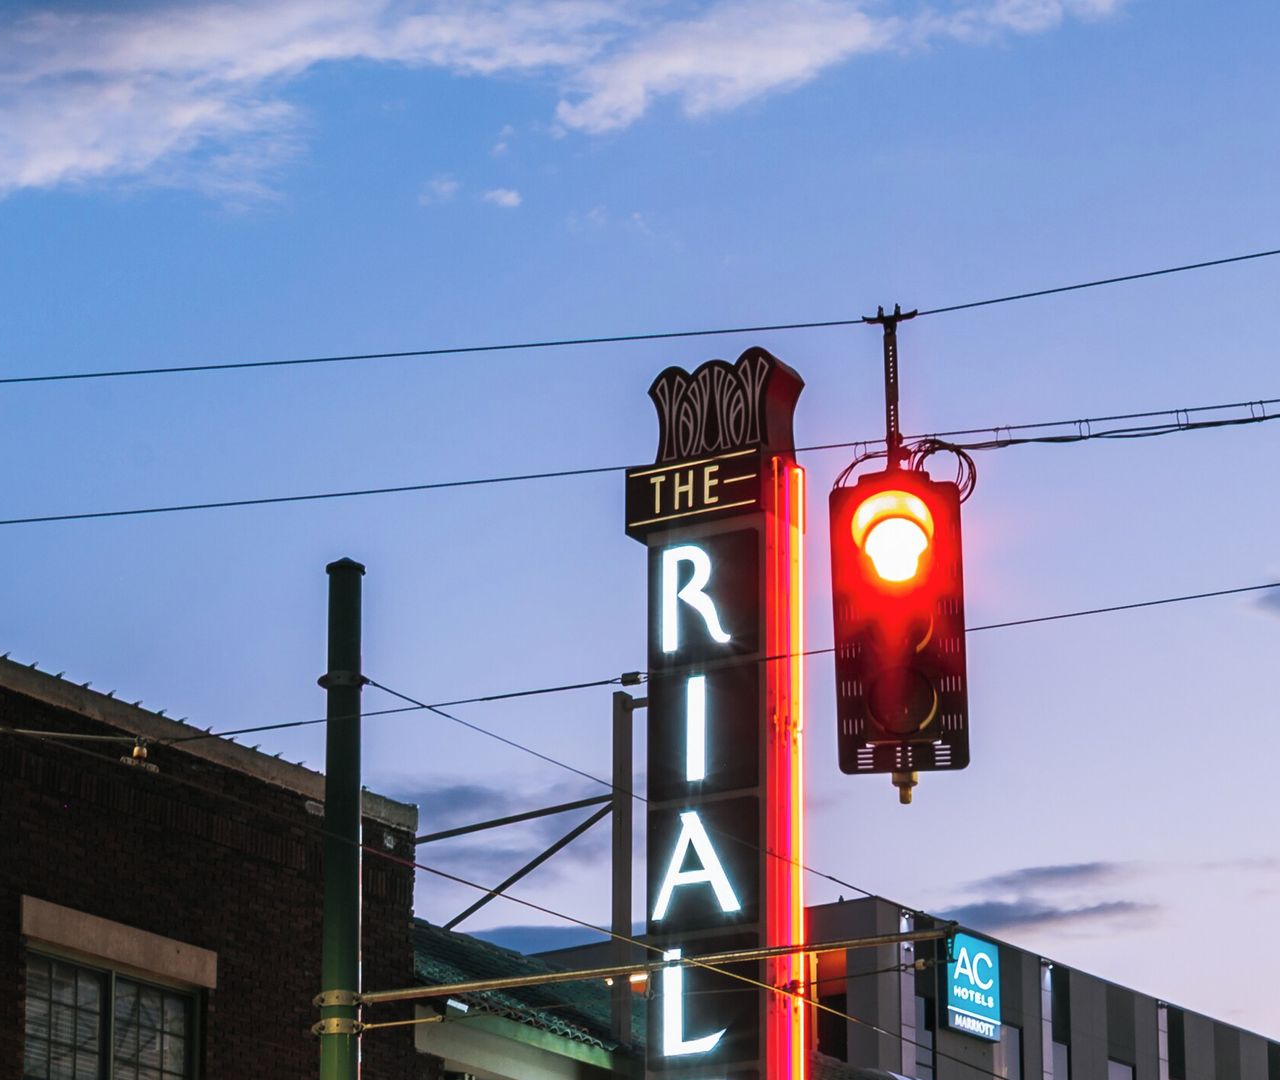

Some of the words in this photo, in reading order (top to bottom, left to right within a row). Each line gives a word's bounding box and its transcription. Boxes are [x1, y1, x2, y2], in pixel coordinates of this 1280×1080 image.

[650, 465, 719, 514] THE
[954, 947, 993, 990] AC
[953, 985, 994, 1008] HOTELS
[954, 1014, 995, 1037] MARRIOTT
